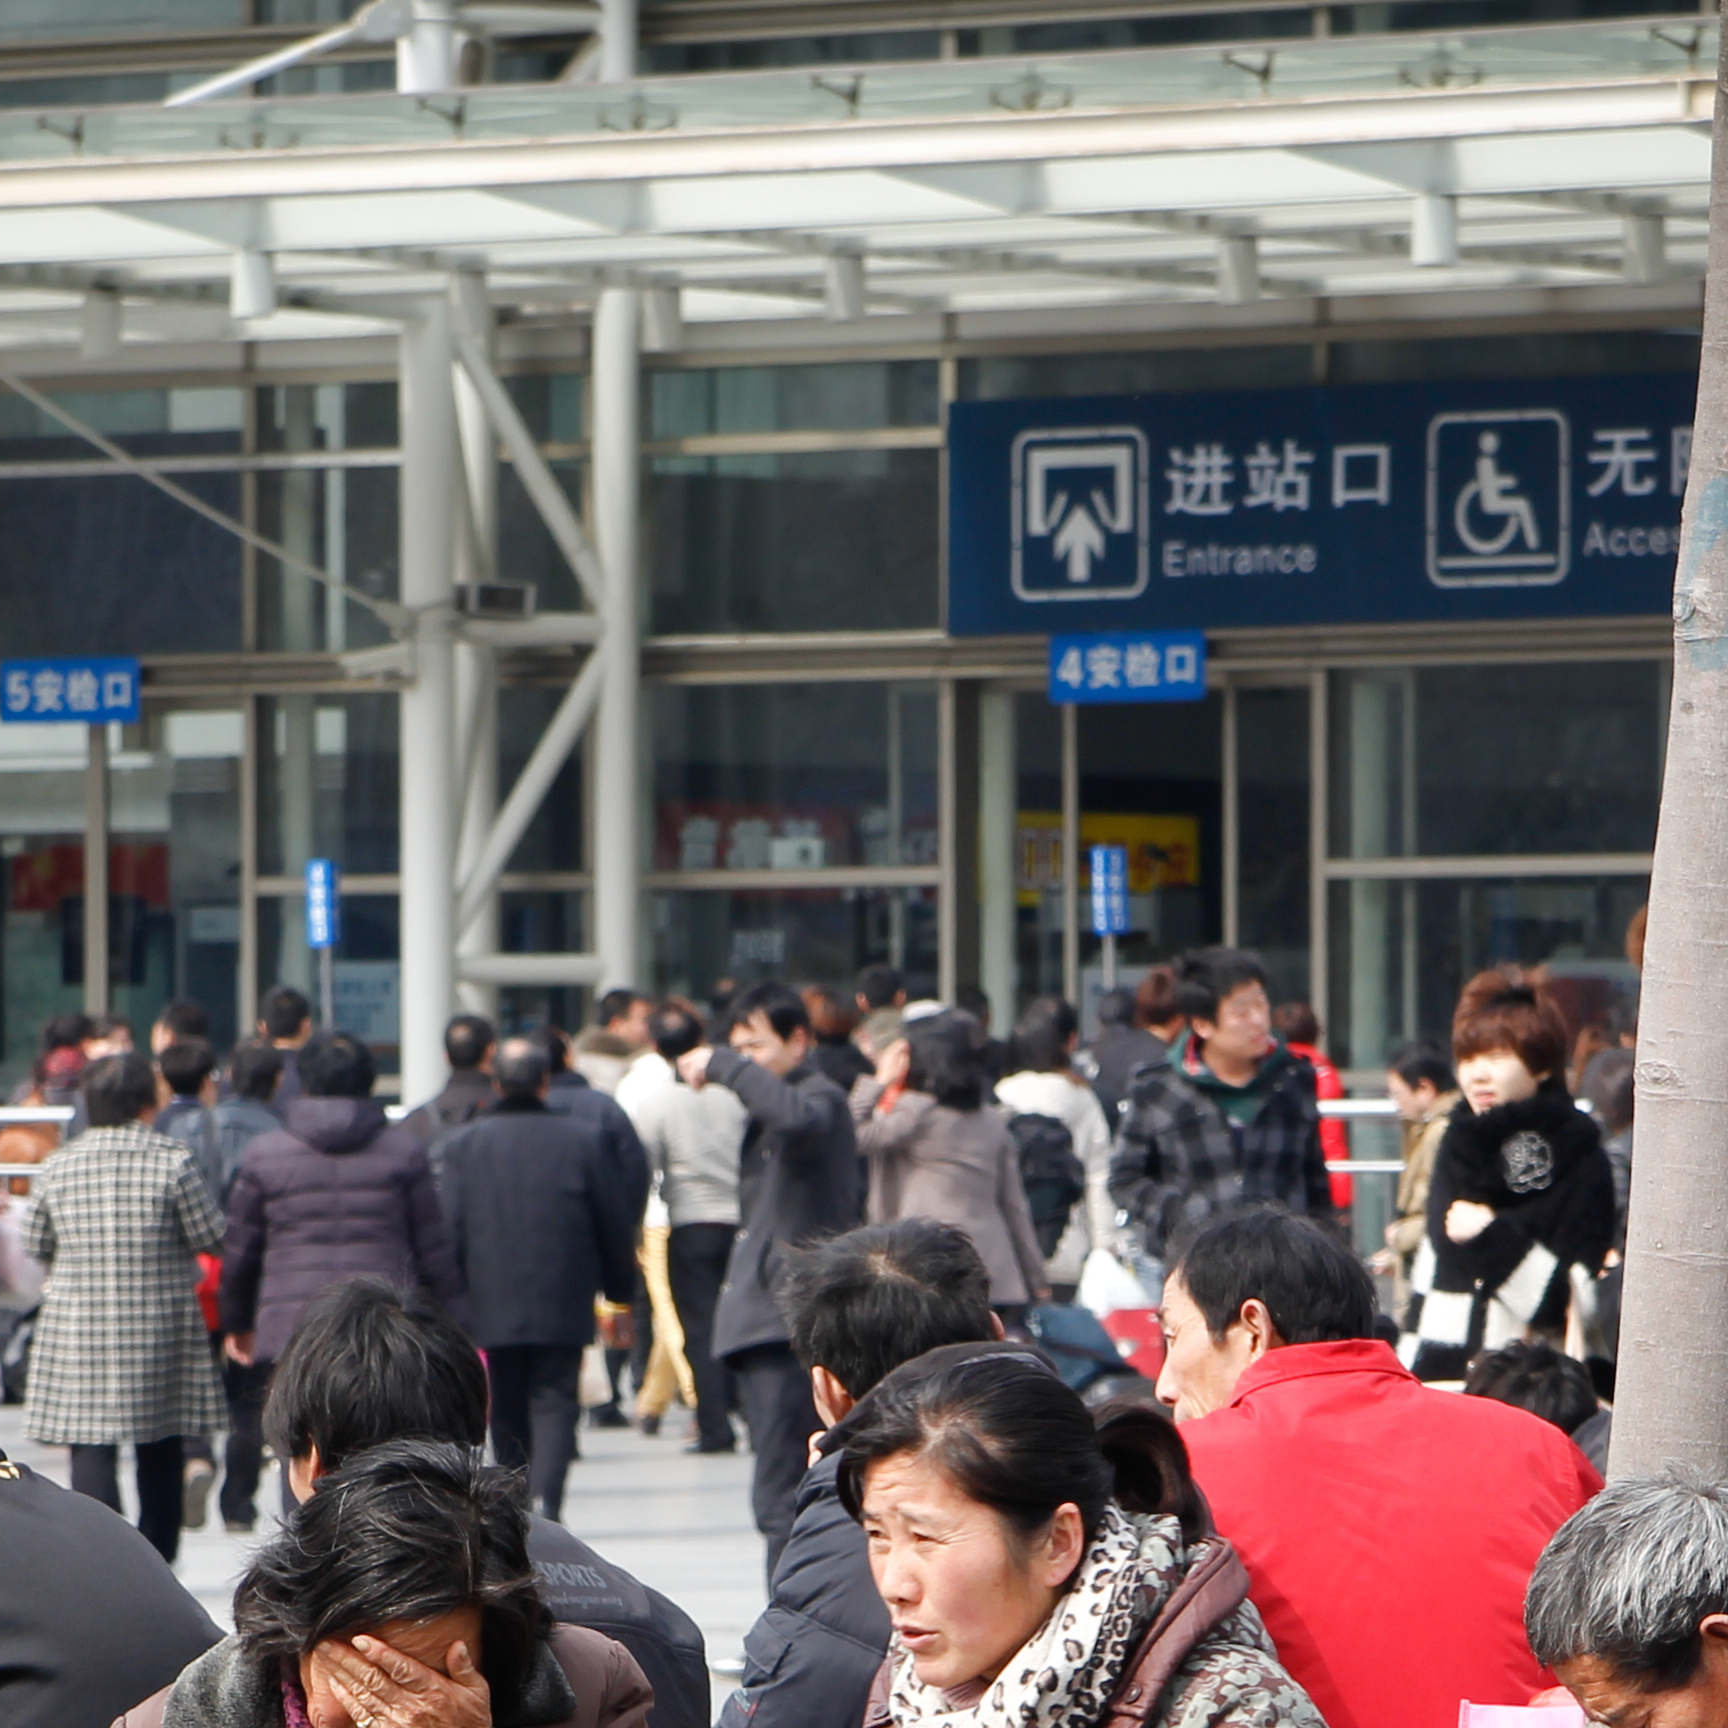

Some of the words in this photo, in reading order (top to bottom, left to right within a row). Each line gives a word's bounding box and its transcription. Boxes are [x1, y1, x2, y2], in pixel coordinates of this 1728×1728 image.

[1164, 438, 1392, 515] 进站口
[1163, 540, 1318, 578] Entrance
[1056, 642, 1198, 690] 4安检口
[5, 668, 133, 713] 5安检口
